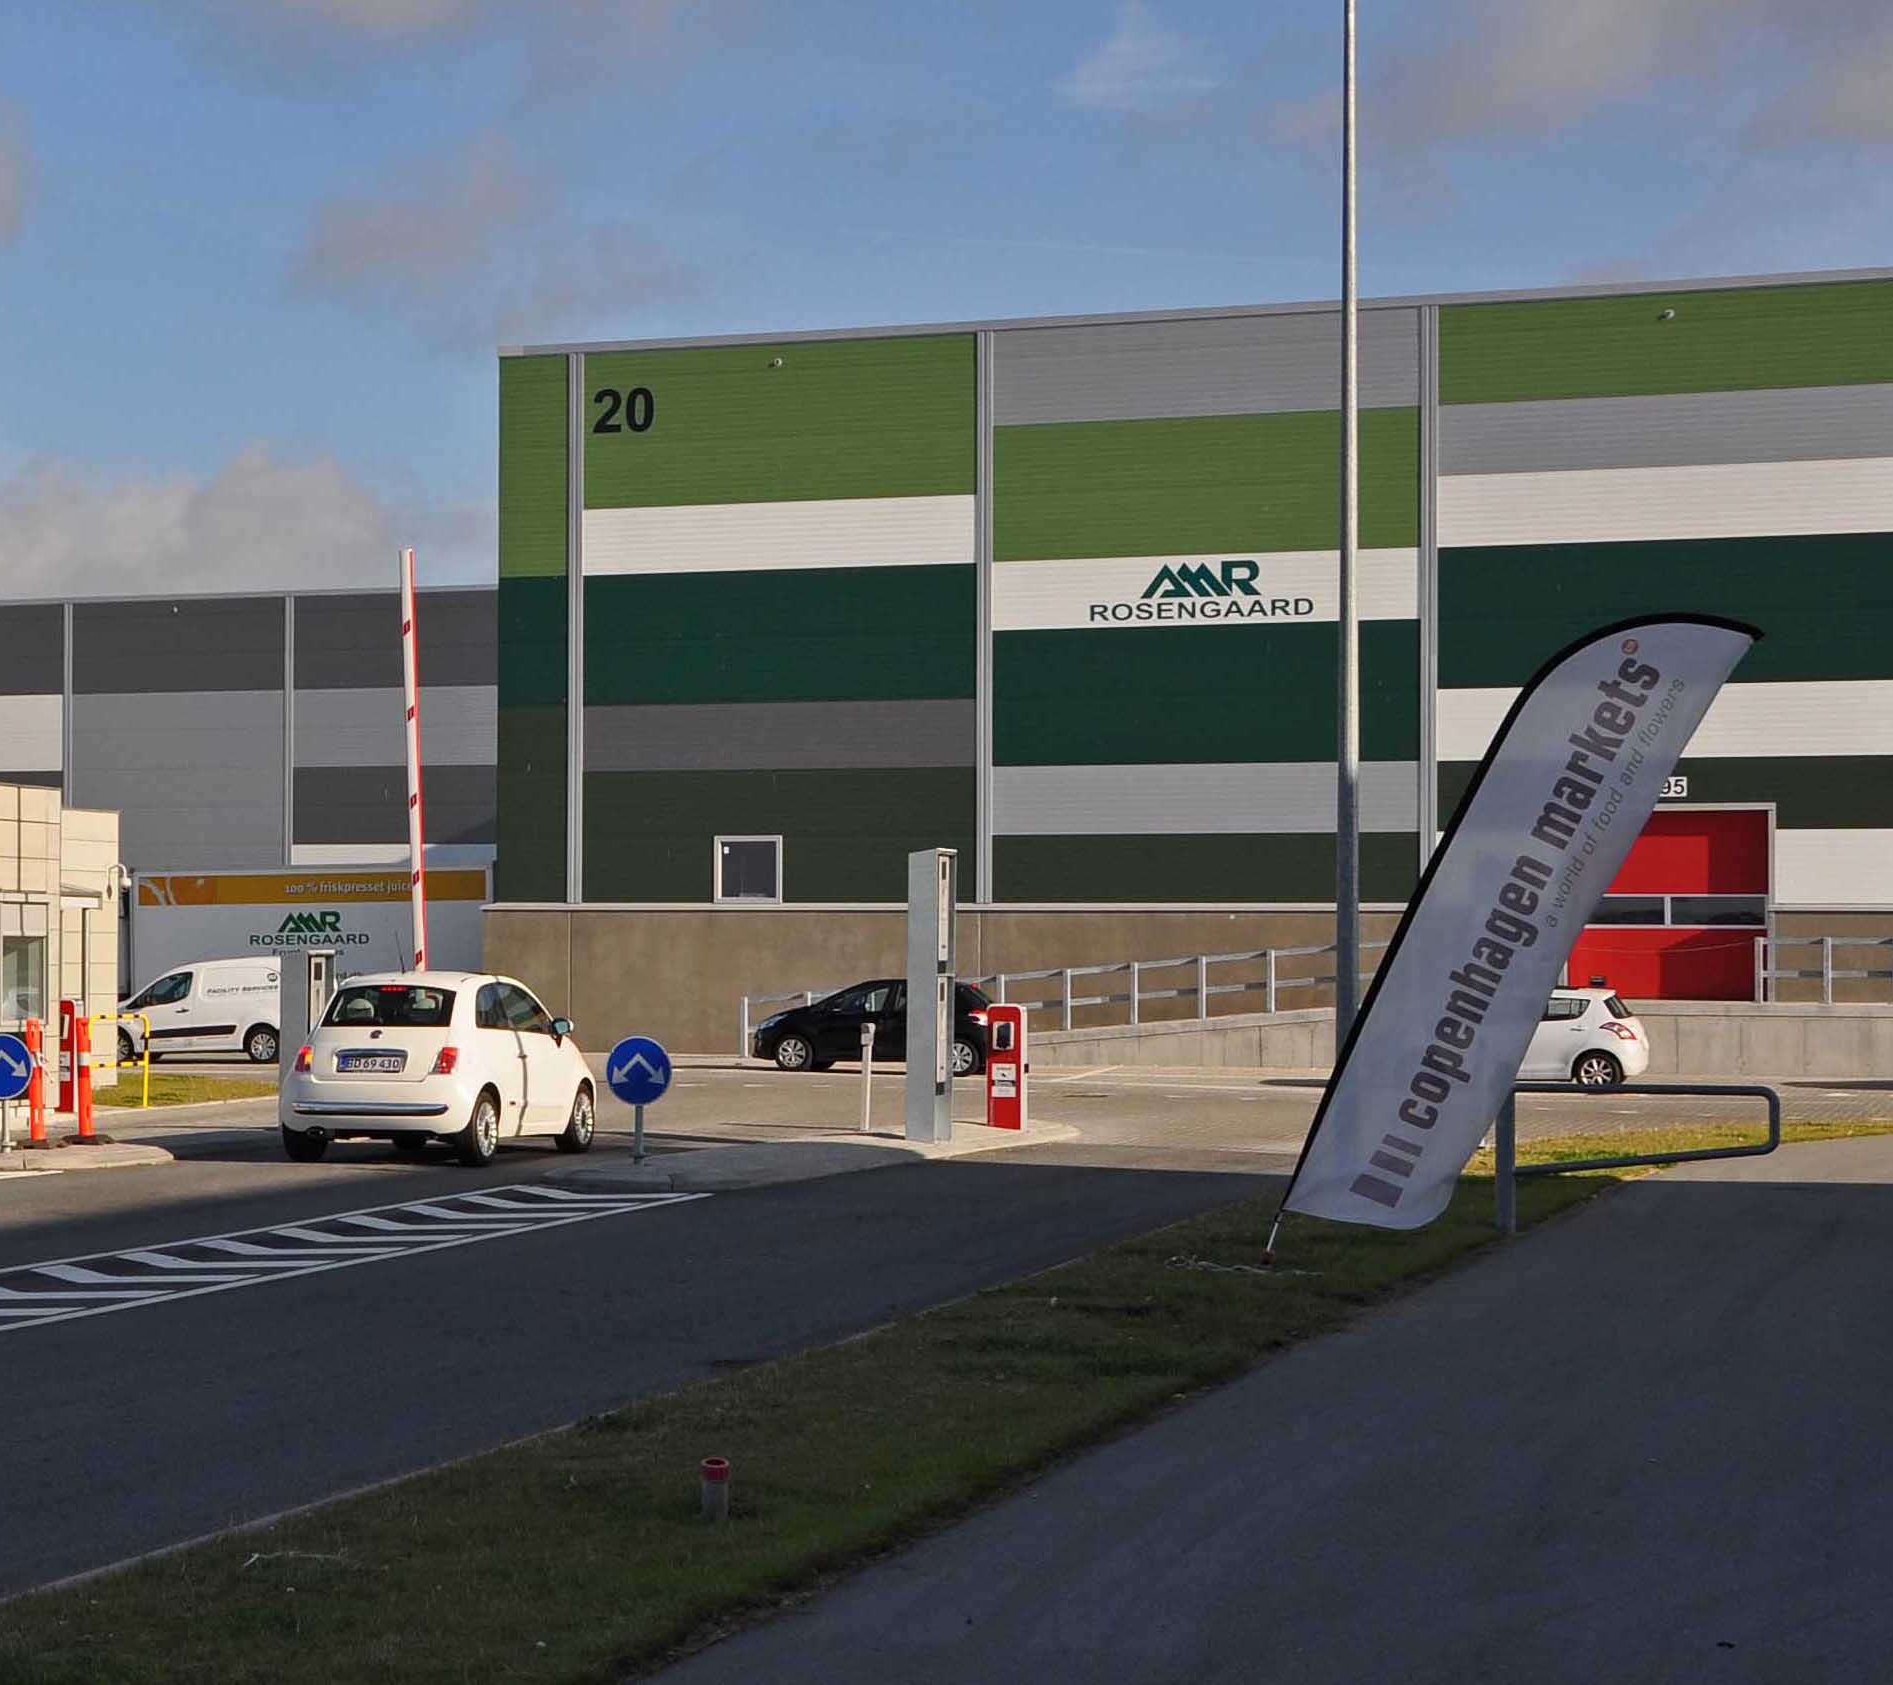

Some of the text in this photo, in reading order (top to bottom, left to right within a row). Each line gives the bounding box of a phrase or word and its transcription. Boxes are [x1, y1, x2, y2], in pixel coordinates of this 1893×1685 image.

[593, 387, 654, 433] 20
[1141, 559, 1262, 599] AMR
[1089, 597, 1314, 622] ROSENGAARD
[1546, 678, 1686, 928] a world of food and flowers
[1399, 657, 1660, 1130] copenhagen markets
[250, 933, 370, 946] ROSENGAARD
